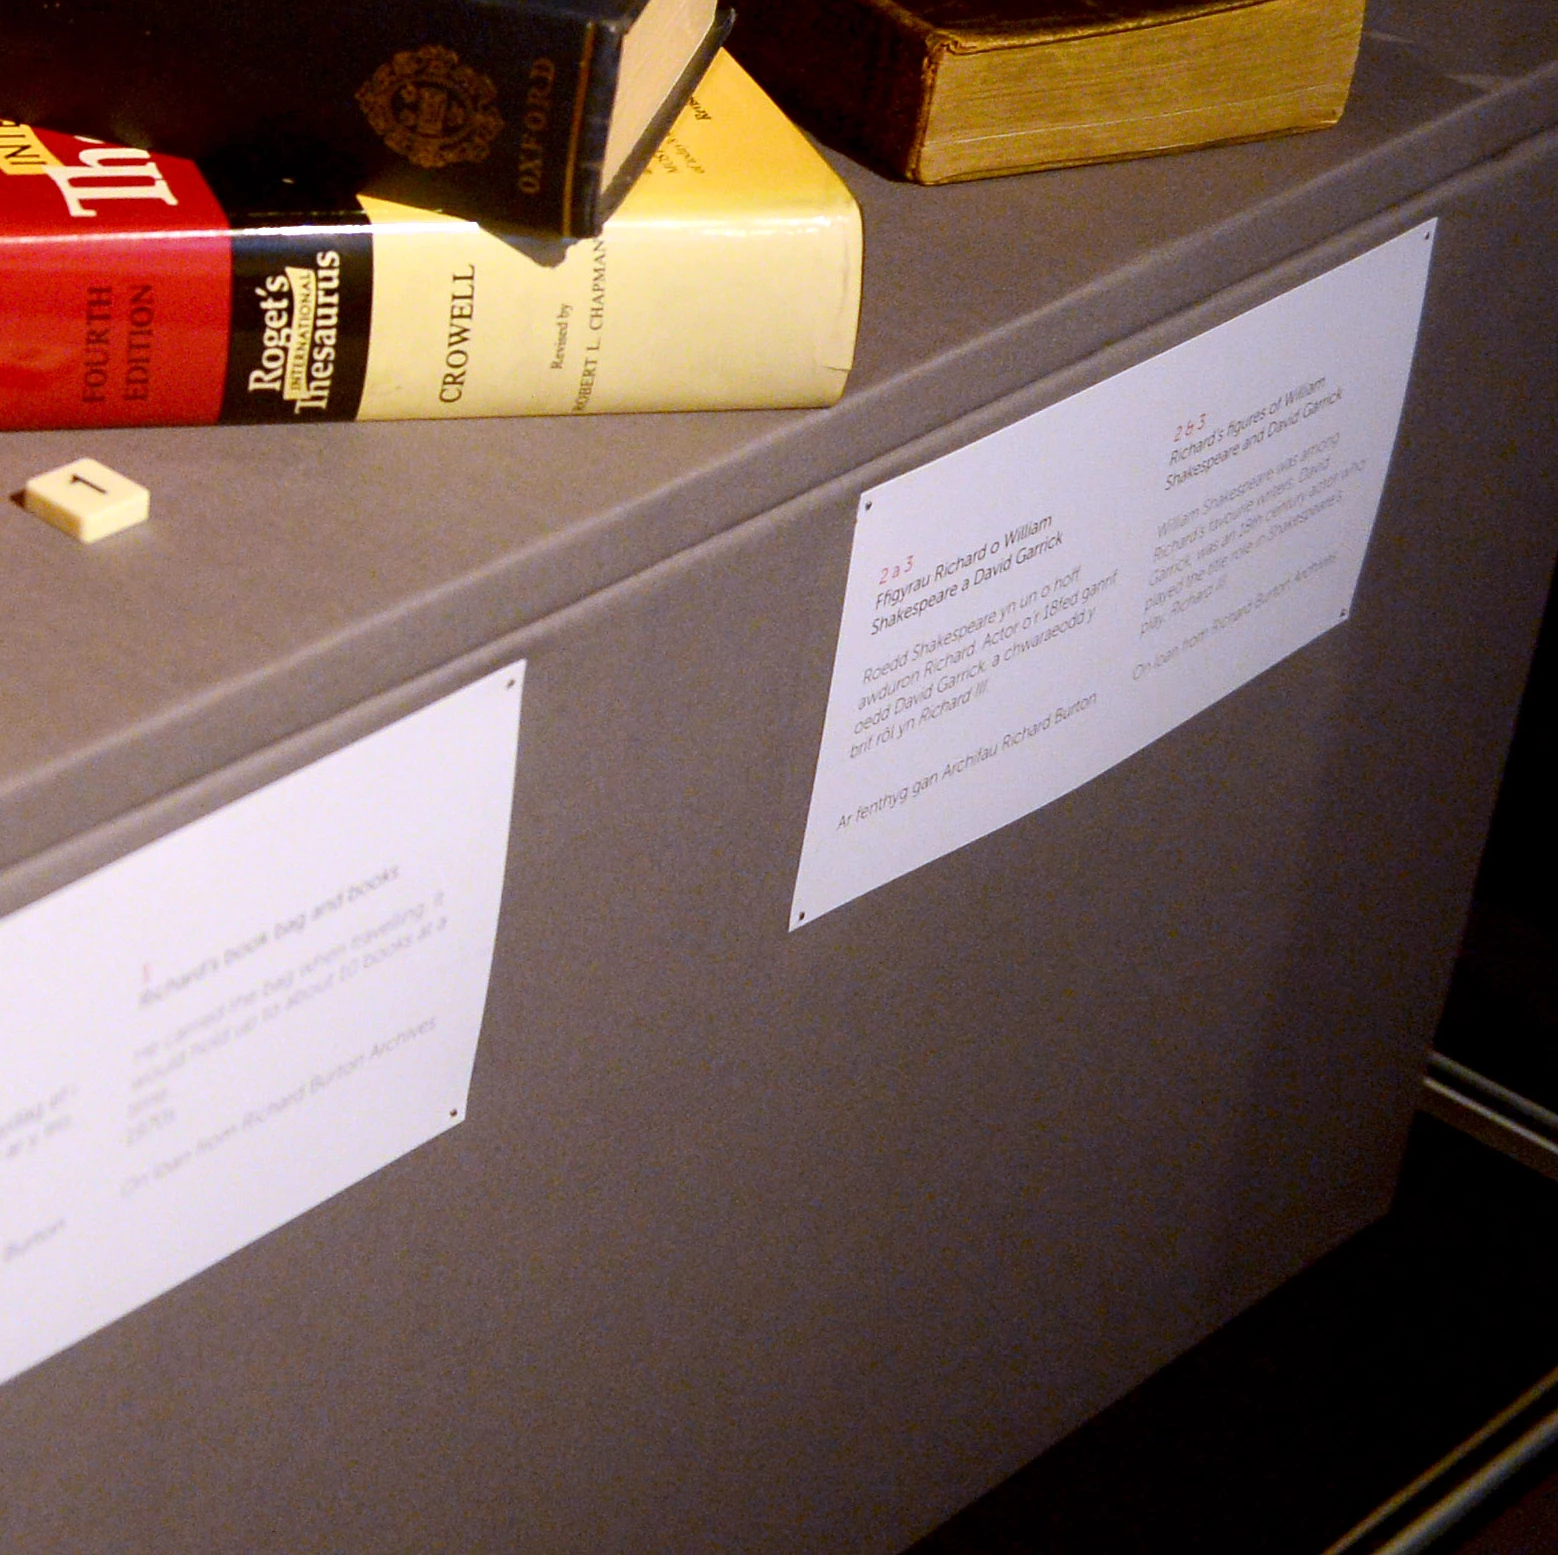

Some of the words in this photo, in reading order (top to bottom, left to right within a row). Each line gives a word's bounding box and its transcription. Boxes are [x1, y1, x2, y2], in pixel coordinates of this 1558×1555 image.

[44, 135, 178, 217] Th
[518, 58, 555, 195] OXFORD
[83, 284, 113, 404] FOURTH
[124, 284, 154, 403] EDITION
[249, 273, 288, 393] Roget's
[290, 269, 314, 393] INTERNATIONAL
[295, 250, 341, 415] Thesaurus
[439, 264, 477, 404] CROWELL
[550, 321, 568, 370] Revised
[557, 302, 573, 319] by
[1164, 443, 1240, 491] Shakespeare
[1242, 431, 1264, 451] and
[1268, 408, 1300, 437] David
[1302, 386, 1343, 419] Garrick
[1169, 427, 1225, 466] Richard's
[1227, 407, 1267, 438] figures
[1269, 397, 1282, 415] of
[1285, 377, 1326, 407] William
[1174, 425, 1183, 443] 2
[70, 474, 108, 495] 1
[871, 584, 957, 636] Shakespeare
[961, 577, 970, 592] a
[973, 554, 1012, 586] David
[1016, 531, 1063, 564] Garrick
[876, 573, 930, 610] Ffigyrau
[934, 542, 985, 582] Richard
[990, 541, 1000, 554] o
[1004, 516, 1052, 547] William
[879, 568, 889, 585] 2
[891, 565, 900, 579] a
[904, 555, 915, 573] 3
[854, 709, 890, 734] oedd
[894, 684, 933, 715] David
[991, 653, 1001, 668] a
[1003, 610, 1085, 663] chwaraeodd
[1085, 606, 1096, 624] y
[858, 669, 919, 710] awduron
[983, 620, 1019, 646] Actor
[863, 654, 906, 684] Roedd
[912, 611, 995, 661] Shakespeare
[998, 601, 1016, 622] yn
[1020, 590, 1037, 609] un
[1041, 585, 1050, 598] o
[1053, 565, 1081, 592] hoff
[836, 814, 852, 831] Ar
[856, 786, 908, 821] fenthyg
[912, 771, 938, 798] gan
[942, 742, 998, 780] Archifau
[1002, 714, 1052, 751] Richard
[1054, 693, 1097, 725] Burton
[896, 717, 915, 739] yn
[918, 689, 971, 727] Richard
